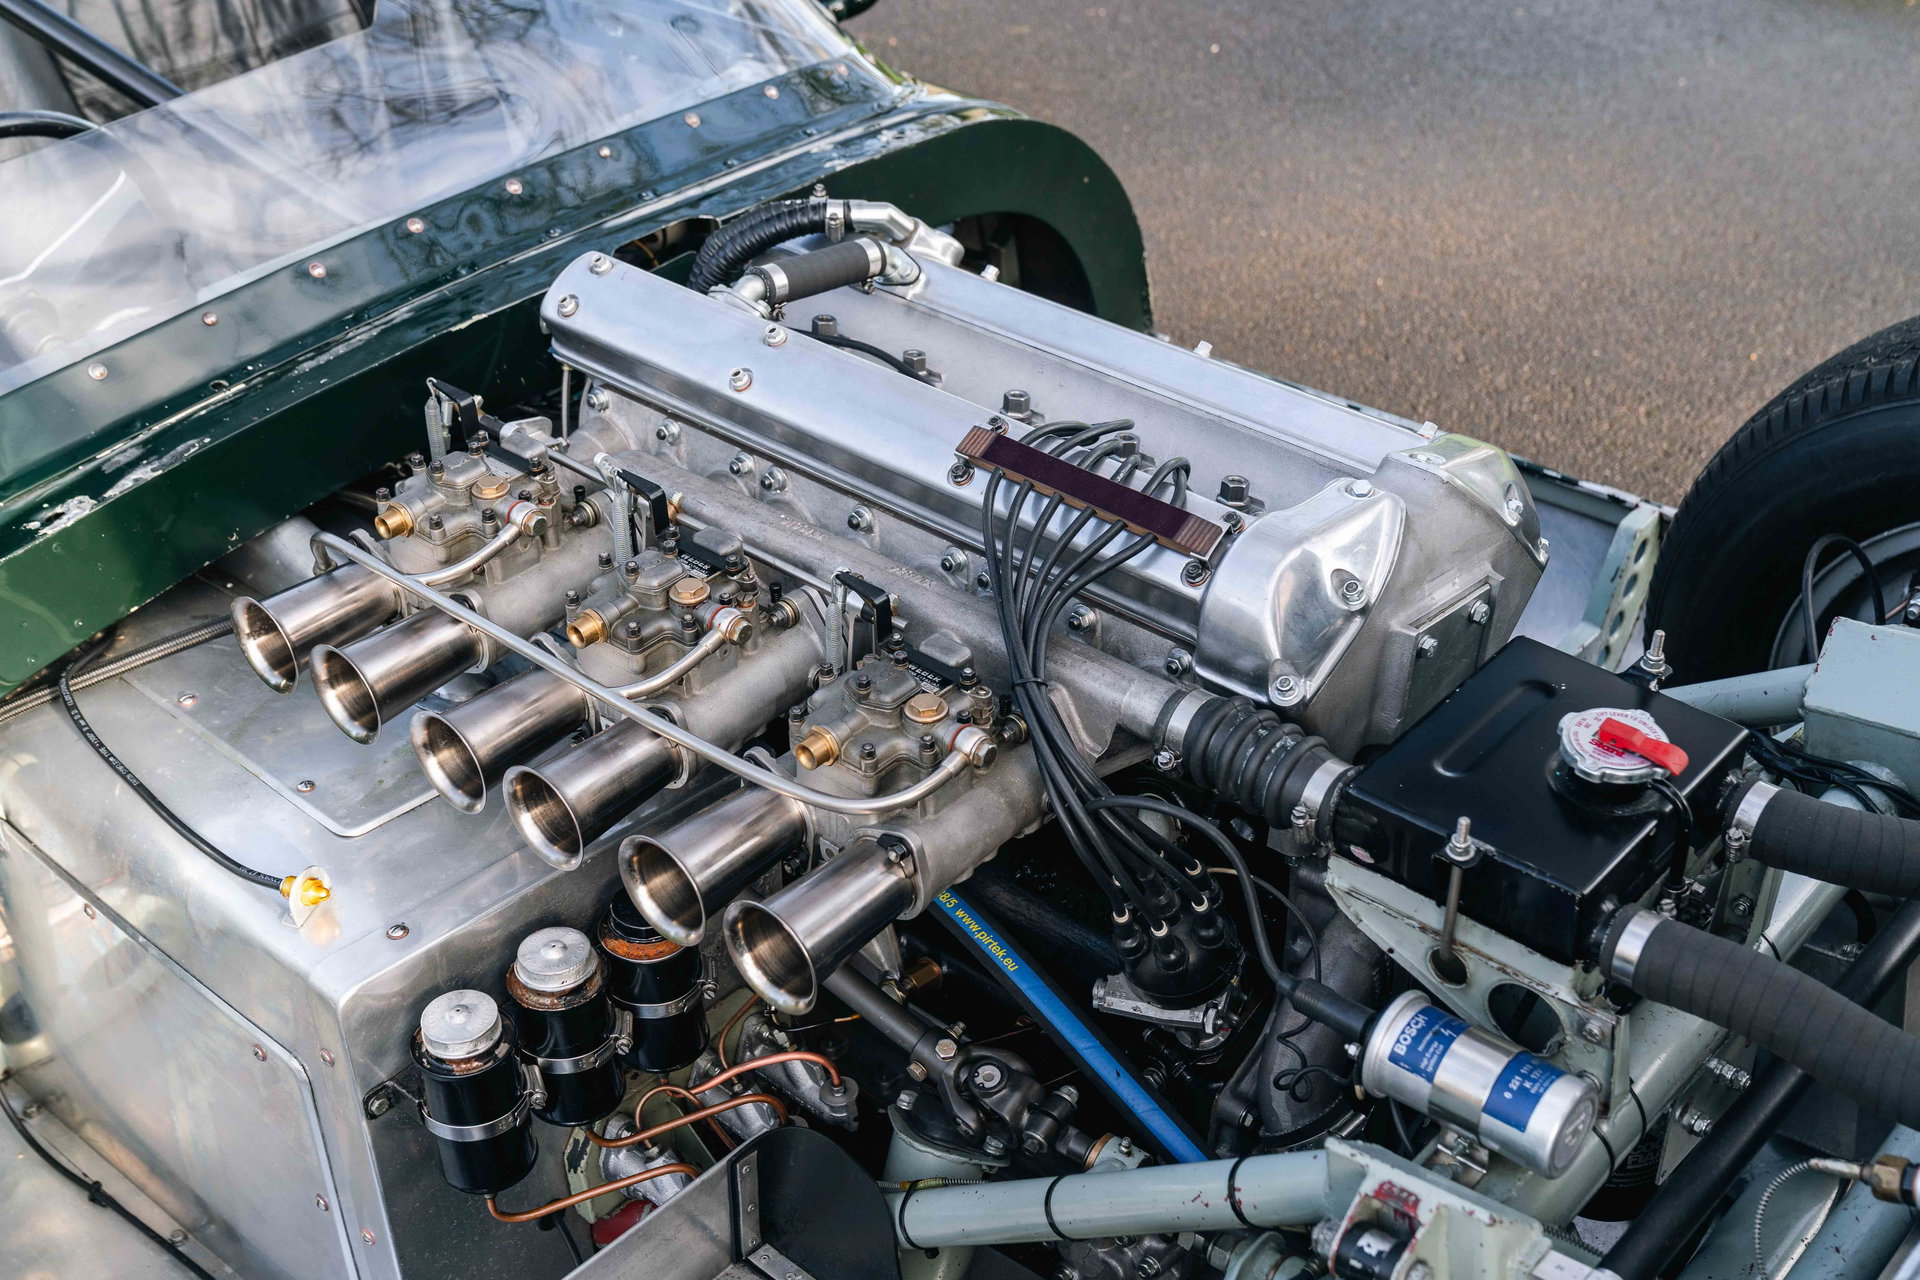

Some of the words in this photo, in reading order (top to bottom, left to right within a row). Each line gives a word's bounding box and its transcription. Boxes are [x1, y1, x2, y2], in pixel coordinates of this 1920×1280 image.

[908, 663, 942, 683] WEBER
[1588, 738, 1626, 758] Stant
[955, 908, 1019, 972] www.pirtek.eu
[1393, 1014, 1429, 1056] BOSCH
[1522, 1079, 1534, 1089] K
[1503, 1091, 1513, 1099] 0
